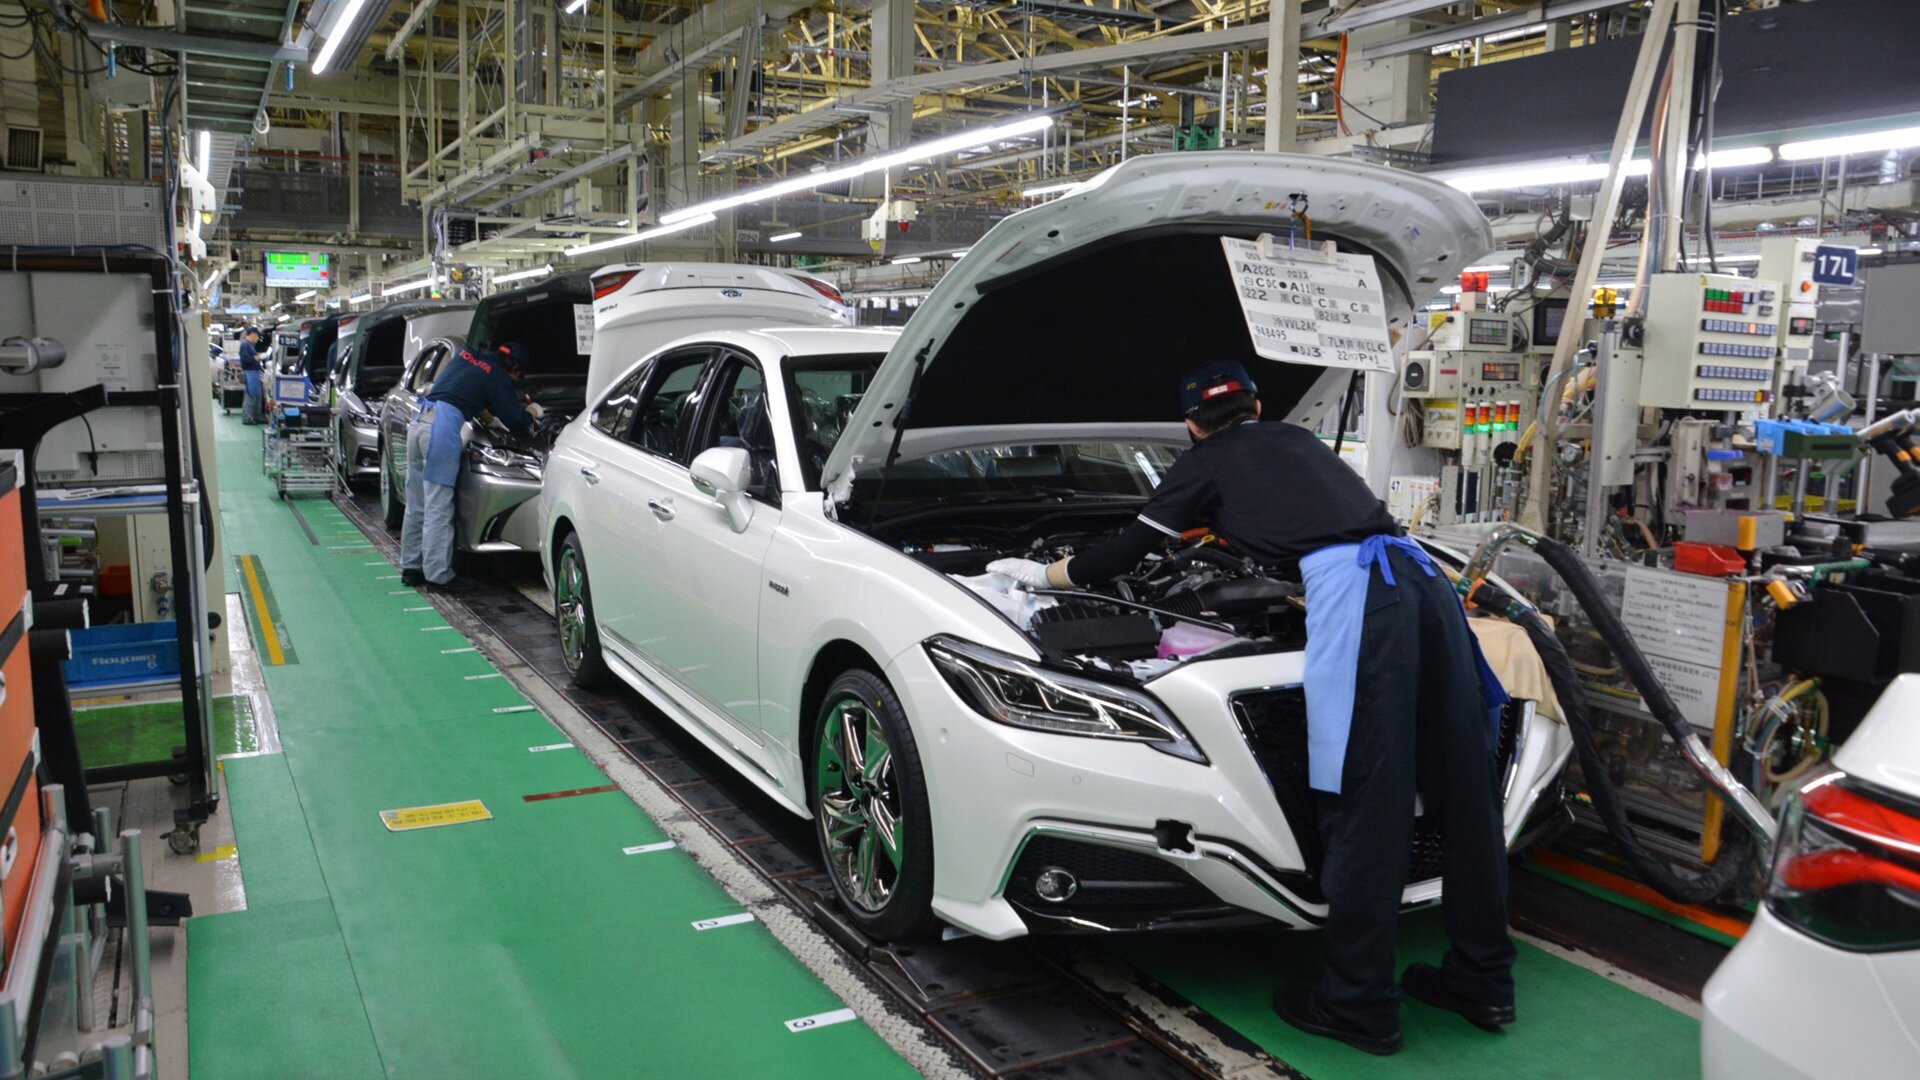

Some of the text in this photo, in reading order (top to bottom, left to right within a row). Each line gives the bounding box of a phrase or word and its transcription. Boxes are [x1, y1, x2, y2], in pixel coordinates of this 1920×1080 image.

[1242, 264, 1275, 277] A2C2C
[1818, 255, 1853, 278] 17L
[1358, 279, 1367, 289] A
[1246, 288, 1268, 301] 222
[459, 349, 492, 374] TOYOTA
[698, 920, 718, 928] 2
[793, 1019, 816, 1028] 3
